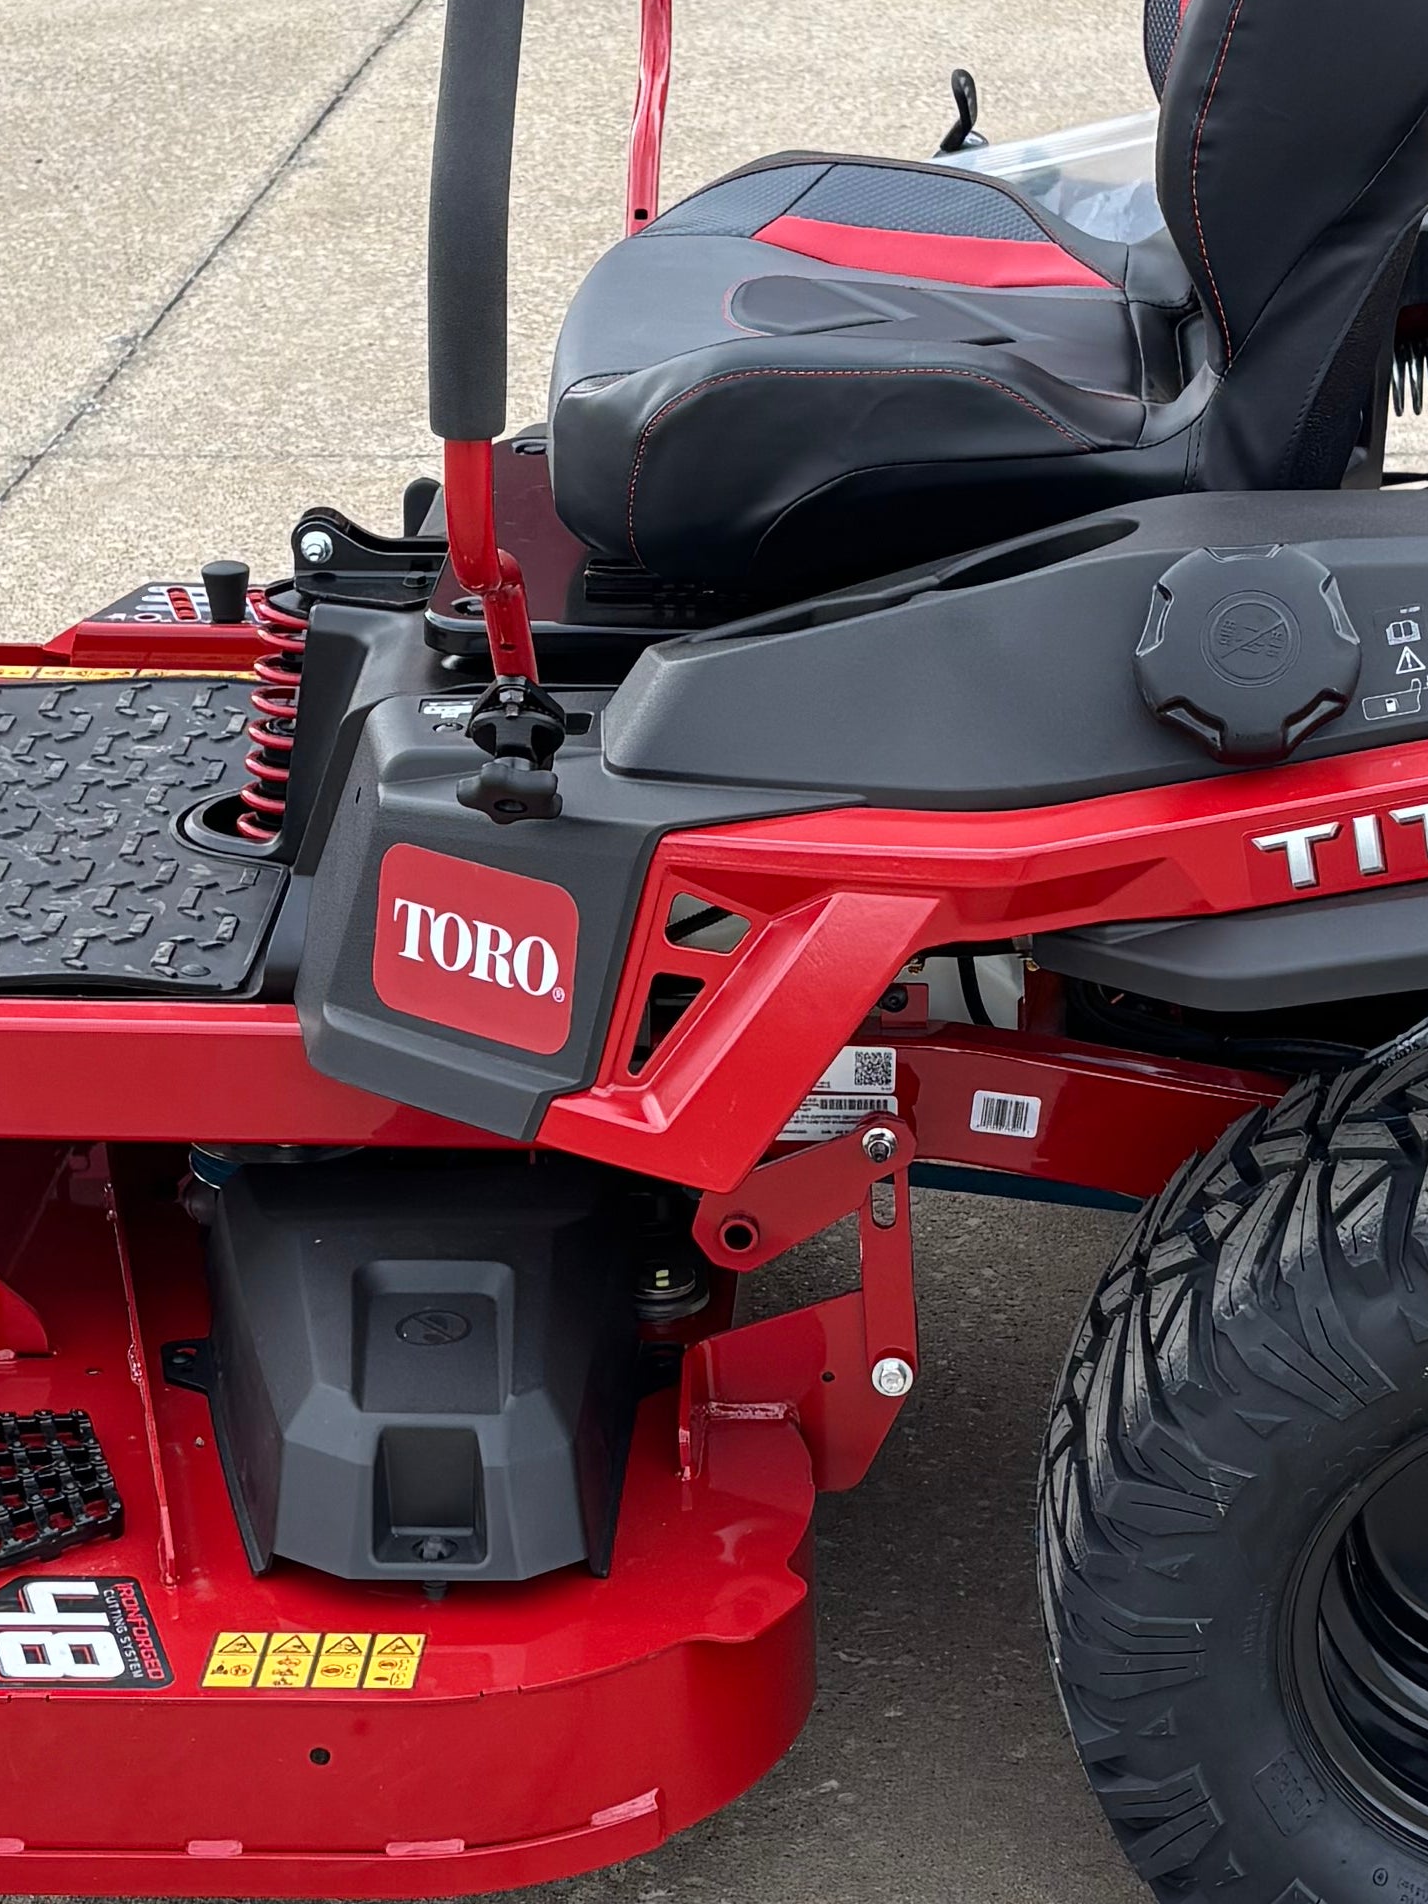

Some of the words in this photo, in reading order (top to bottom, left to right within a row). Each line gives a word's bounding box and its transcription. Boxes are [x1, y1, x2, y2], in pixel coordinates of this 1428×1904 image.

[393, 897, 560, 997] TORO
[102, 1589, 128, 1635] CUTTING
[119, 1635, 144, 1679] SYSTEM
[112, 1581, 166, 1681] IRONFORGED
